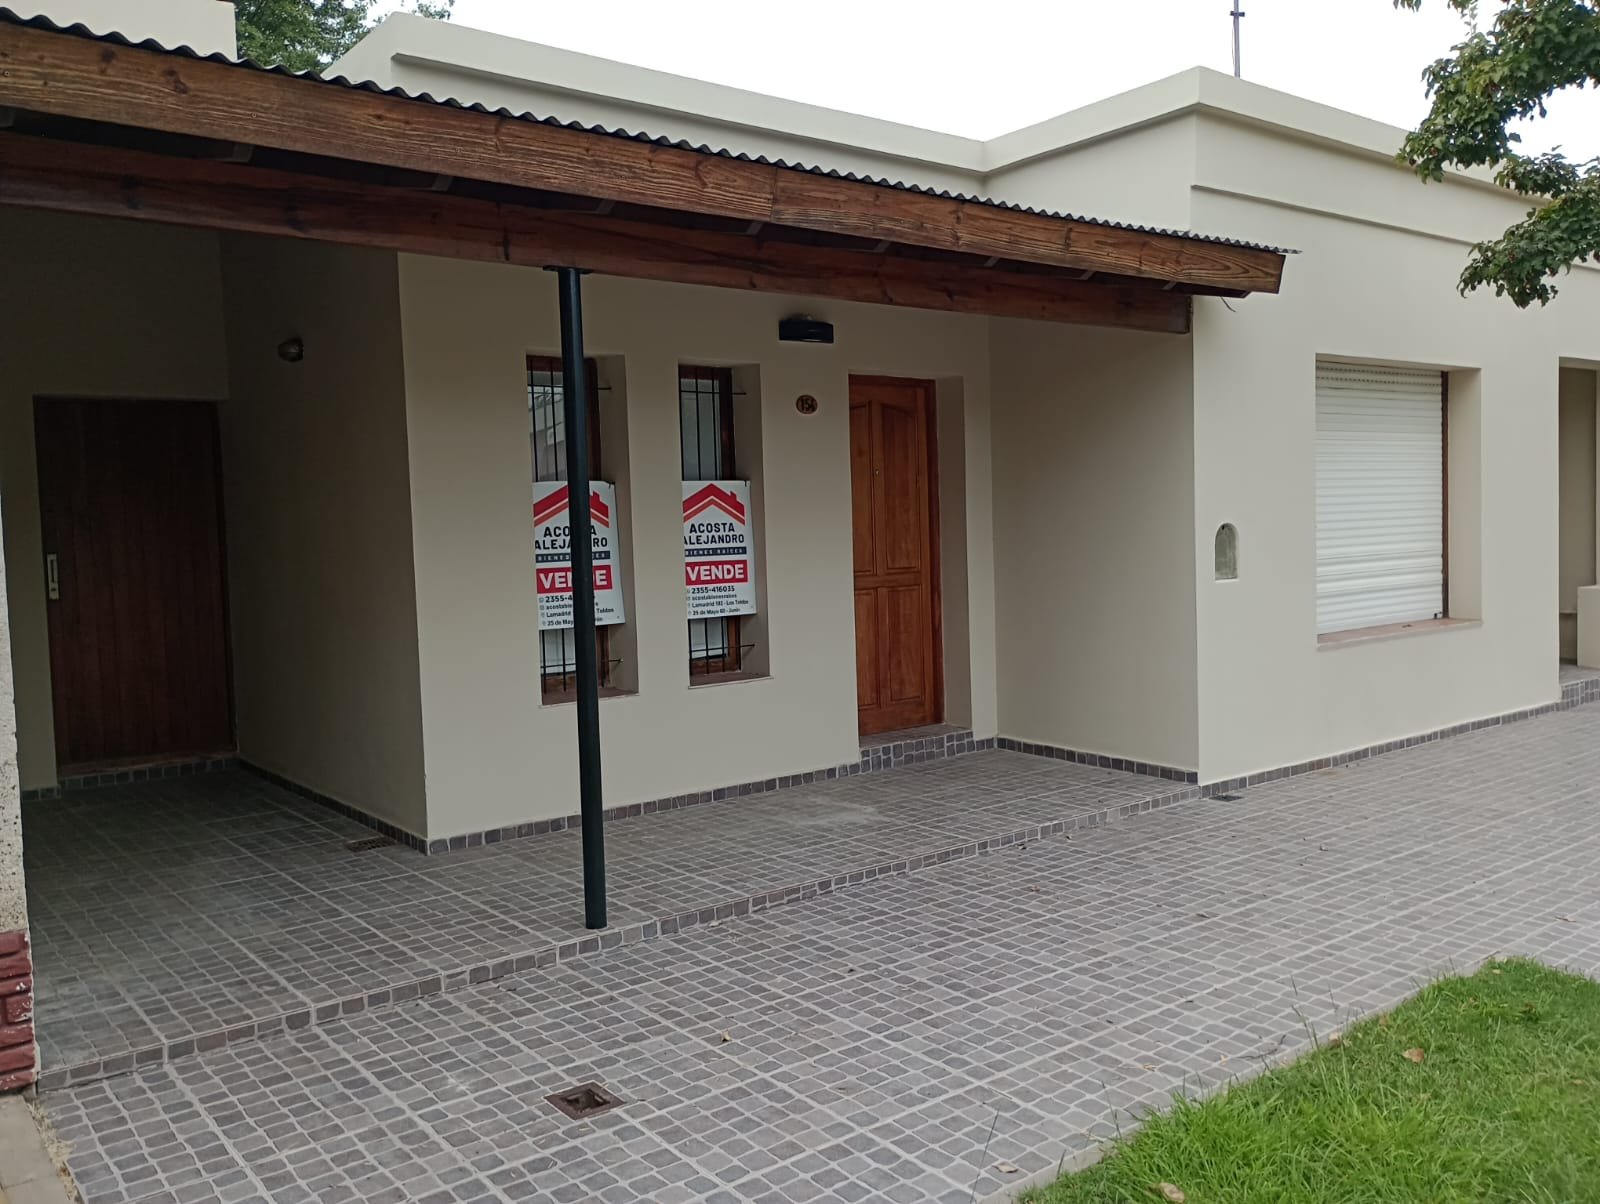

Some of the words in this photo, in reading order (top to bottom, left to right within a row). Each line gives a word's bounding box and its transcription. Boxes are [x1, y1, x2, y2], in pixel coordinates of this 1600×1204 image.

[544, 525, 597, 538] ACOA
[689, 522, 735, 534] ACOSTA
[534, 537, 608, 550] ALEJRO
[539, 569, 608, 590] VEE
[686, 564, 745, 582] VENDE
